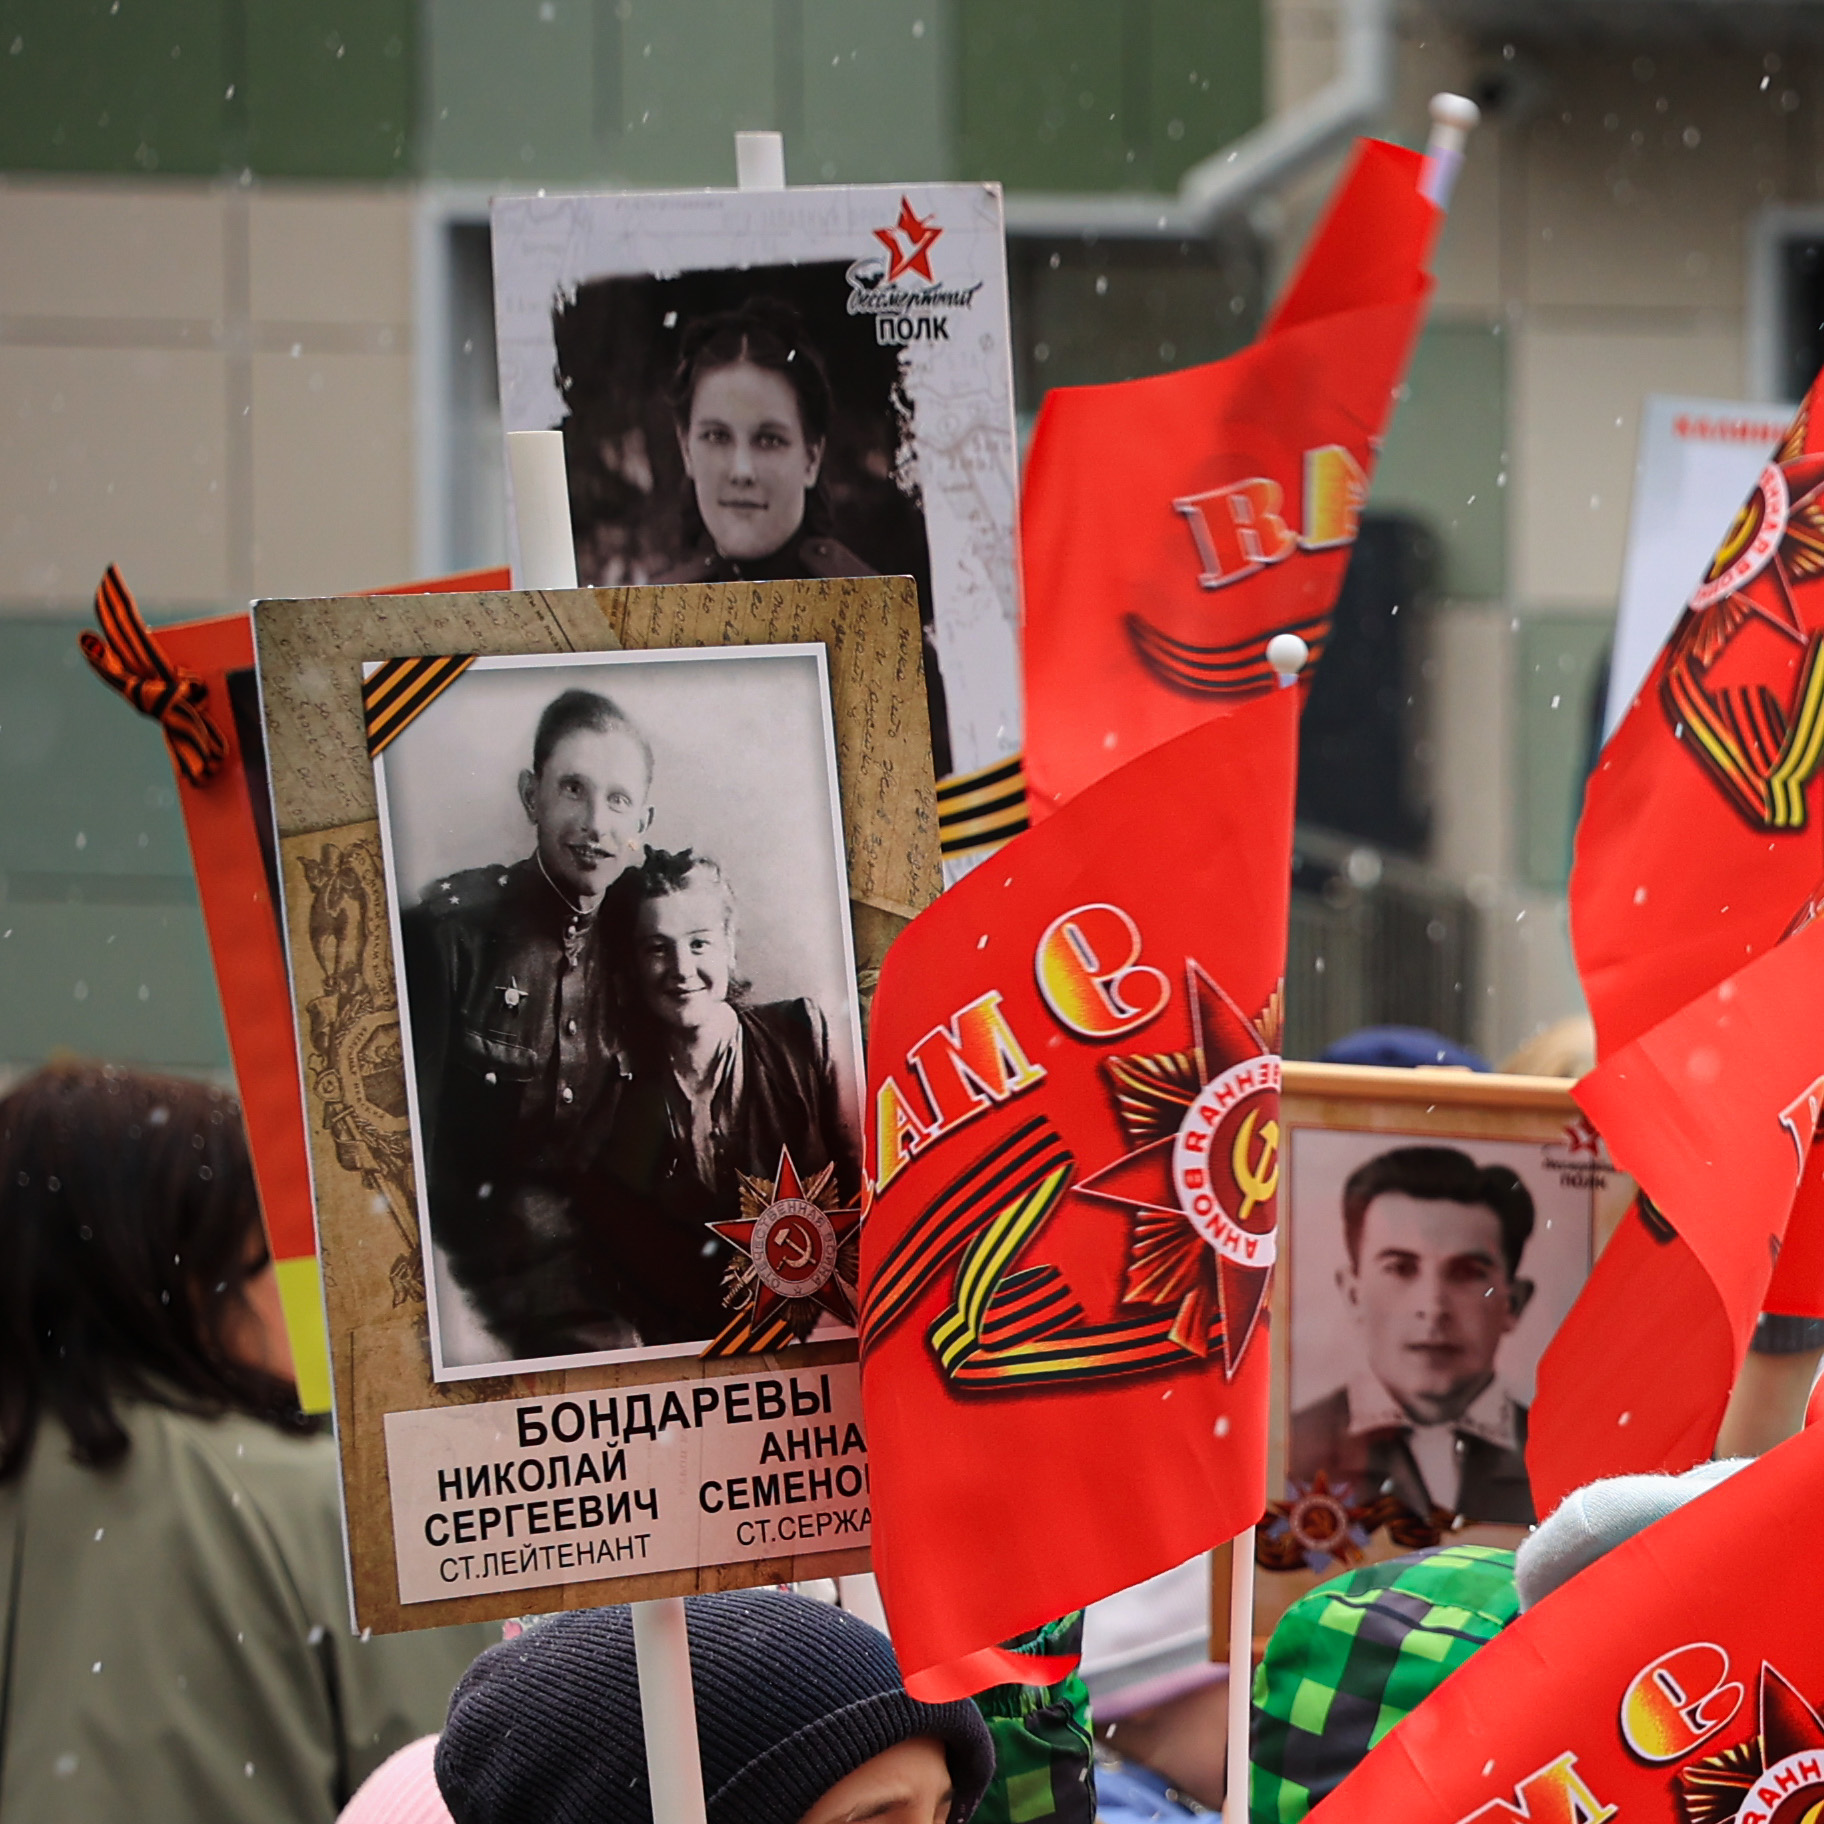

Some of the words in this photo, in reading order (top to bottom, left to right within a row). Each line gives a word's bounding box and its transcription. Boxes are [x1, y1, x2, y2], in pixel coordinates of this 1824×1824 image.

[879, 316, 950, 342] ПОЛК
[515, 1375, 833, 1449] БОНДАРЕВЫ
[758, 1421, 868, 1466] АННА
[437, 1443, 628, 1503] НИКОЛАЙ
[698, 1462, 871, 1515] СЕМЕНО
[423, 1487, 660, 1547] СЕРГЕЕВИЧ
[735, 1506, 873, 1548] СТ.СЕРЖА
[439, 1532, 652, 1584] СТ.ЛЕЙТЕНАНТ
